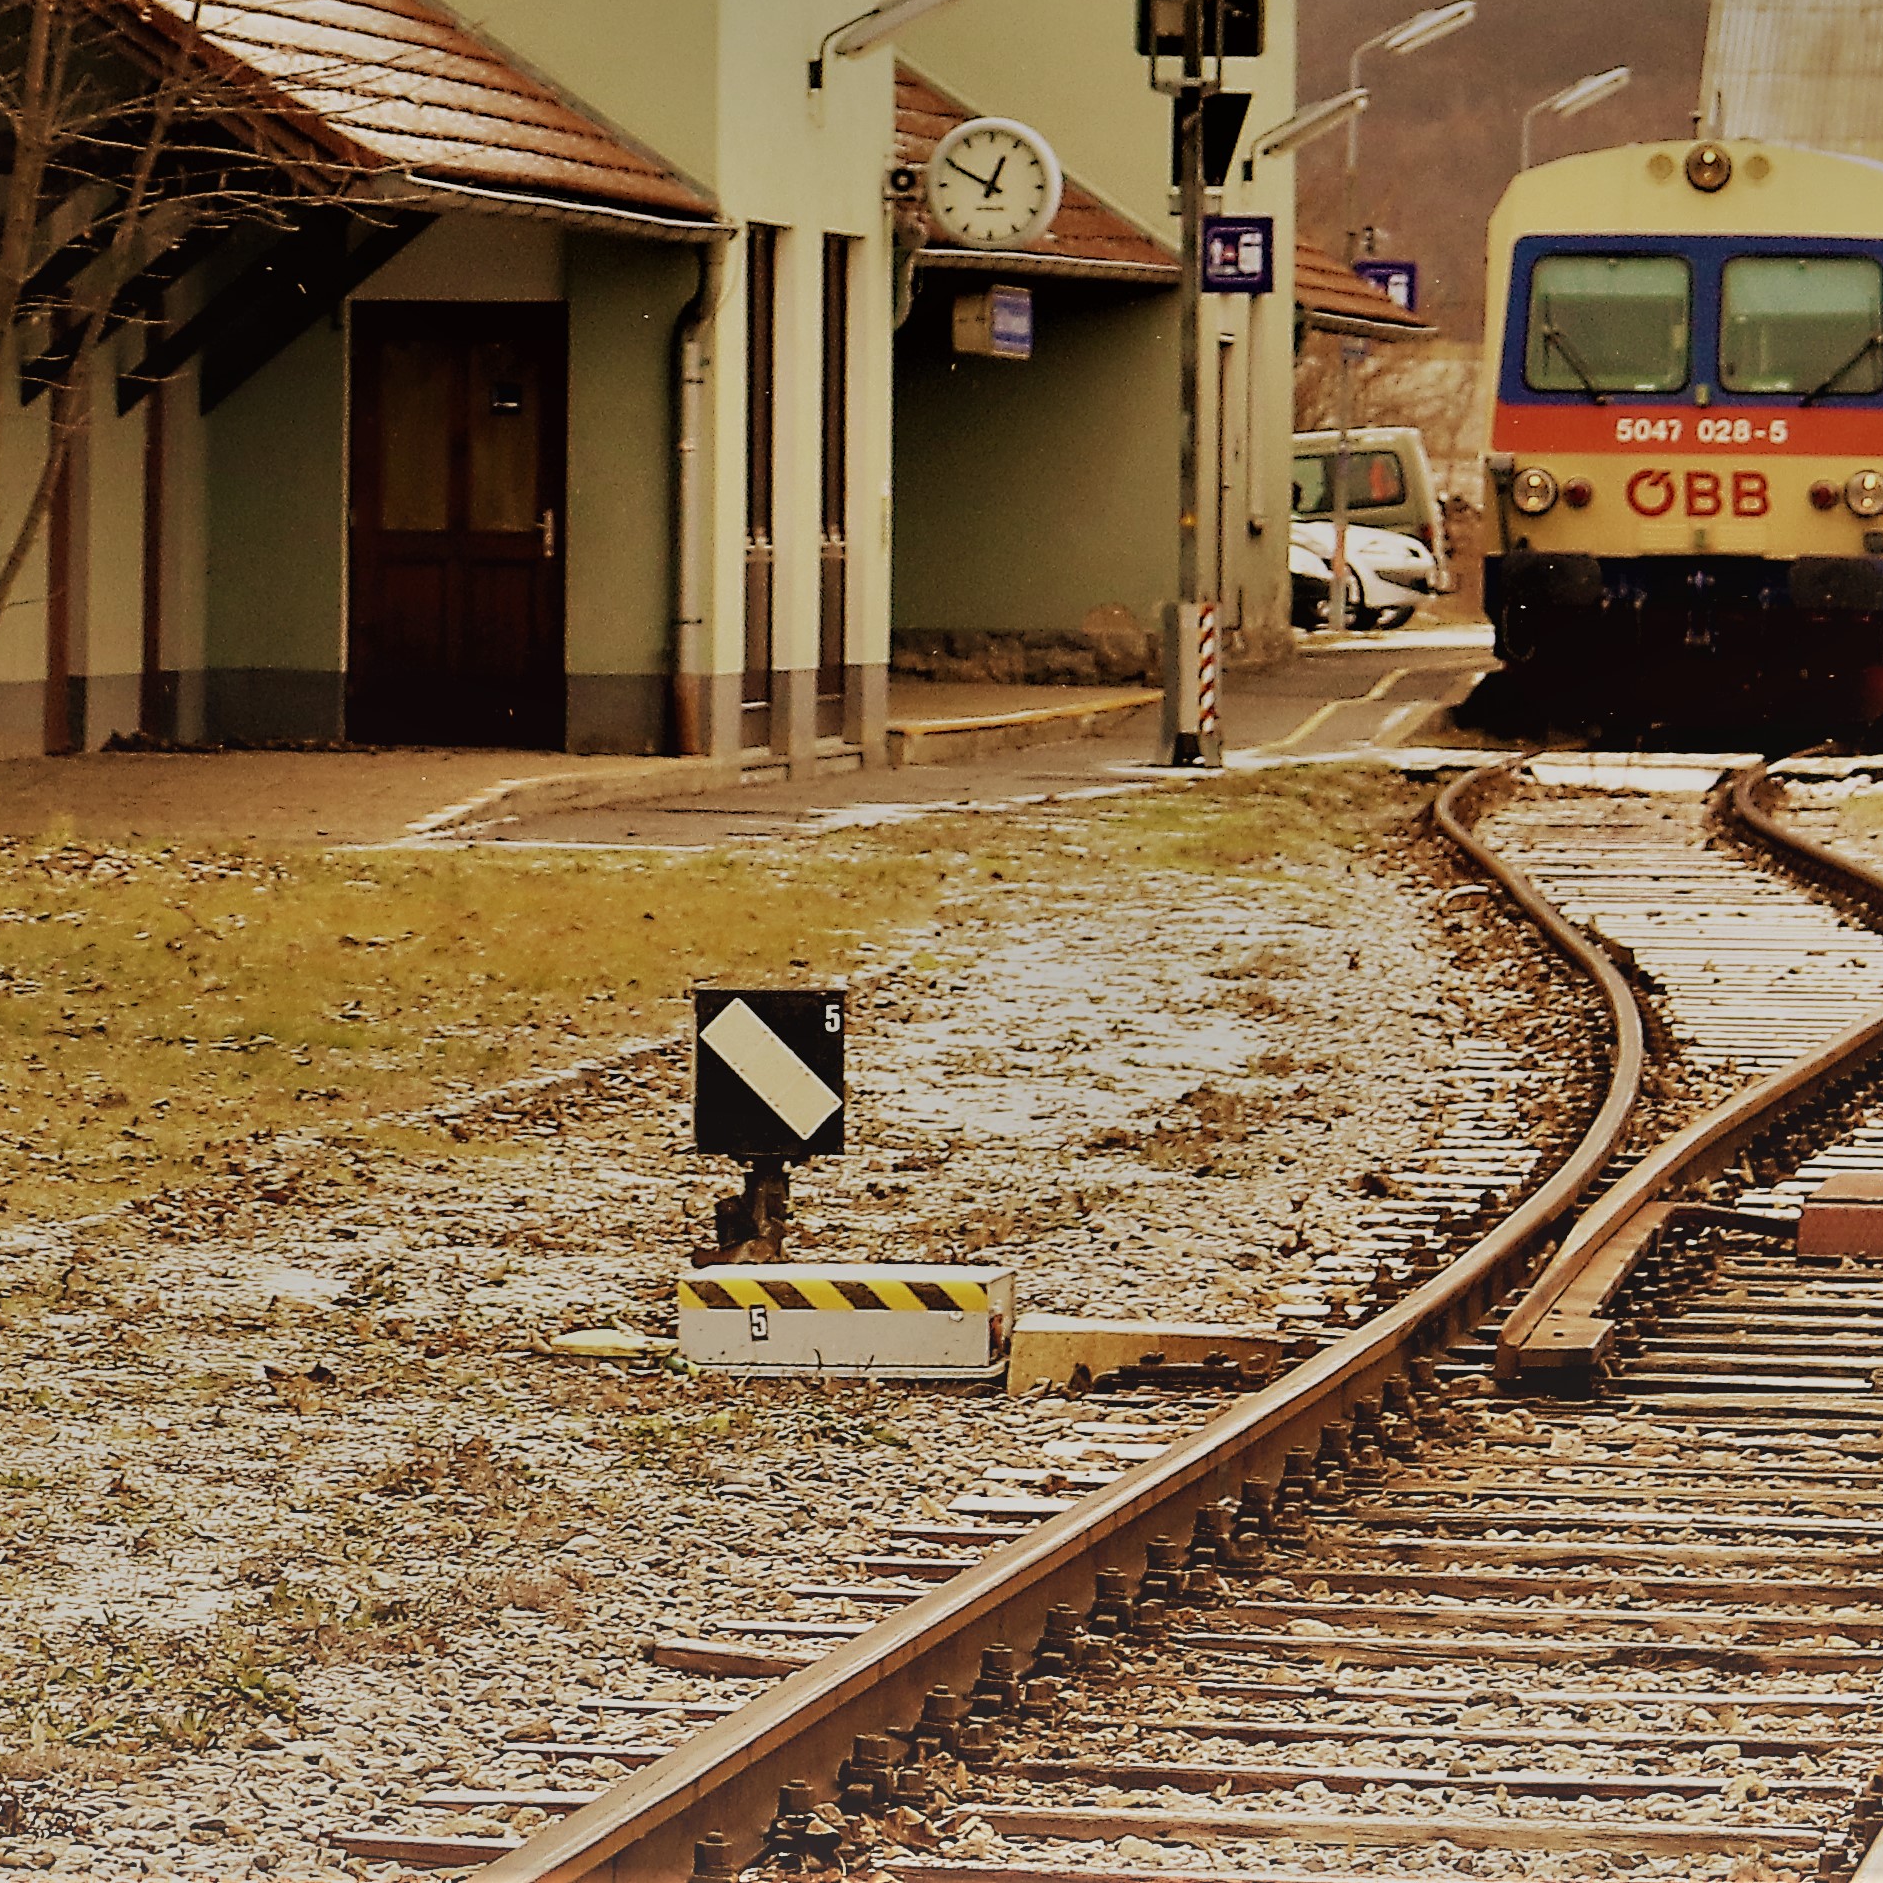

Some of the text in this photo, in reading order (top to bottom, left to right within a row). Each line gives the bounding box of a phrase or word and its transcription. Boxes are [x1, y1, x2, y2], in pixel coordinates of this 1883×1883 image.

[1616, 418, 1789, 444] 5047 028-5
[824, 1004, 841, 1033] 5
[751, 1307, 767, 1337] 5
